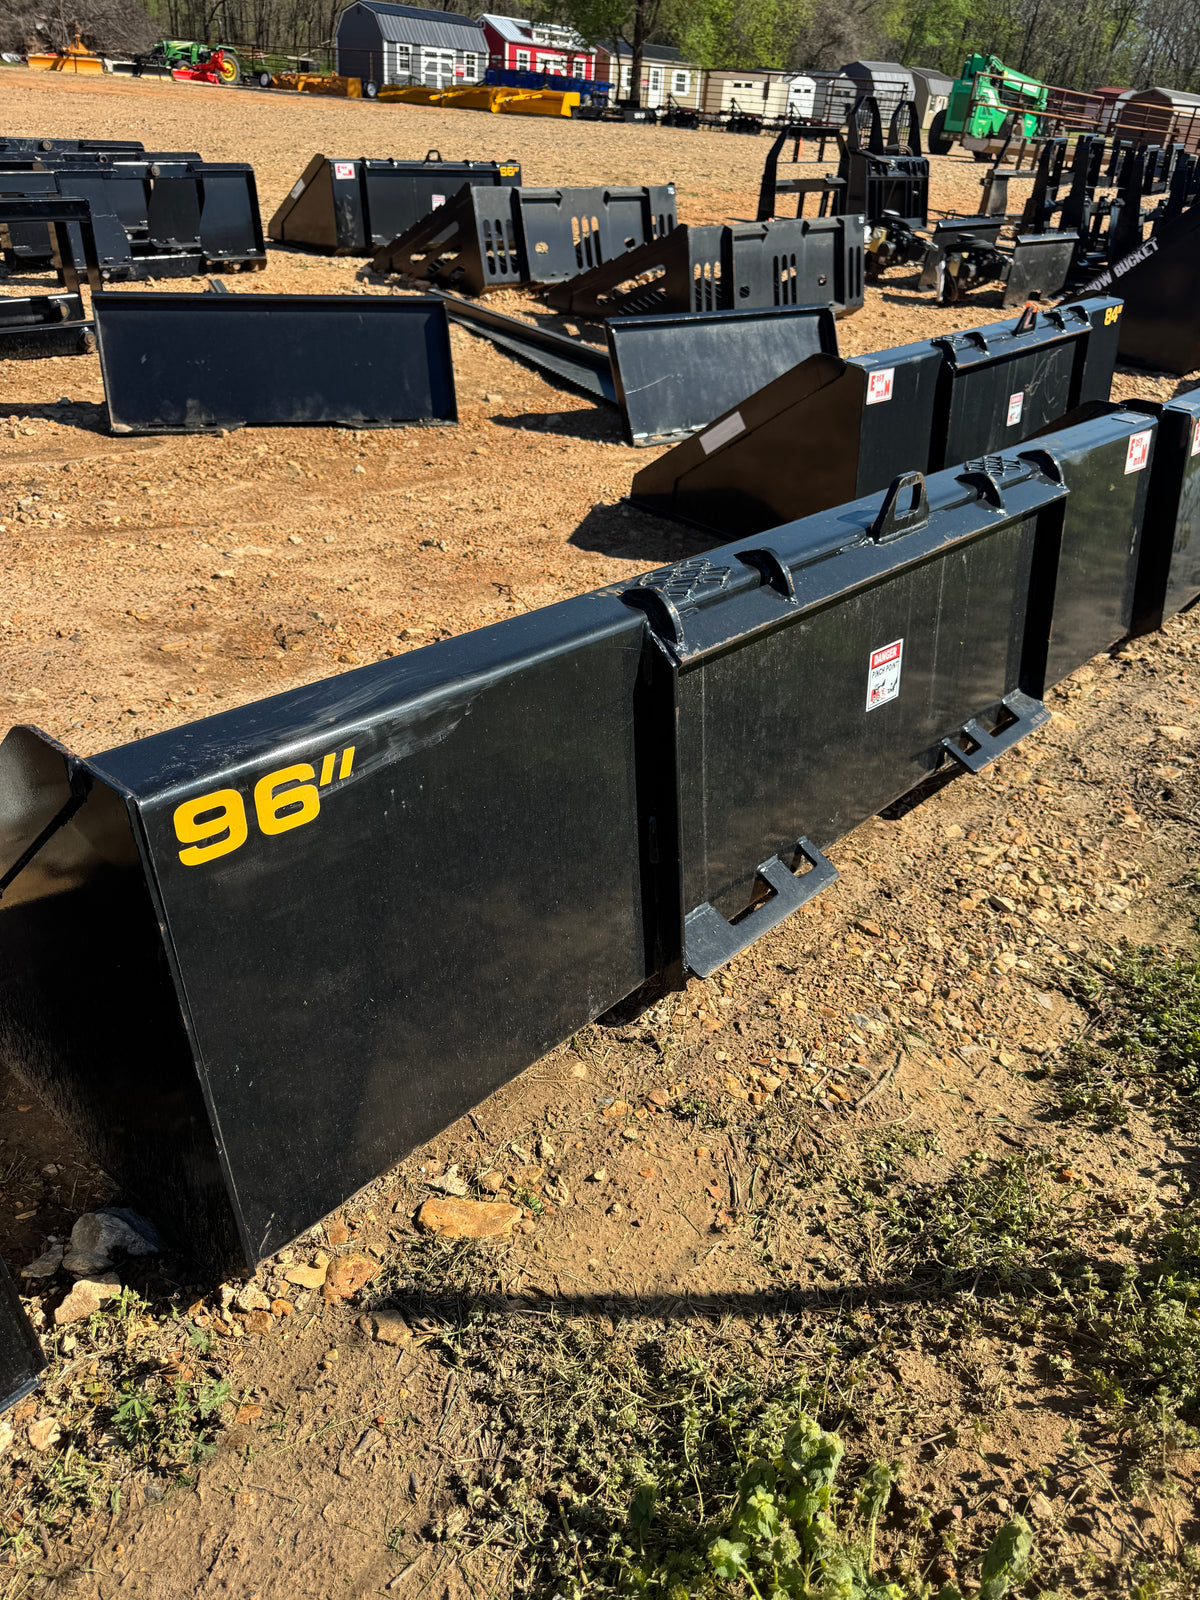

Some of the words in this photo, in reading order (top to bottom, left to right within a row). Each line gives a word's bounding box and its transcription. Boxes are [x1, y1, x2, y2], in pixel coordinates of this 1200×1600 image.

[1113, 236, 1159, 278] BUCKET
[1103, 304, 1124, 326] 84"
[873, 646, 897, 666] DANGER
[872, 667, 885, 679] PINCH
[173, 746, 355, 867] 96"
